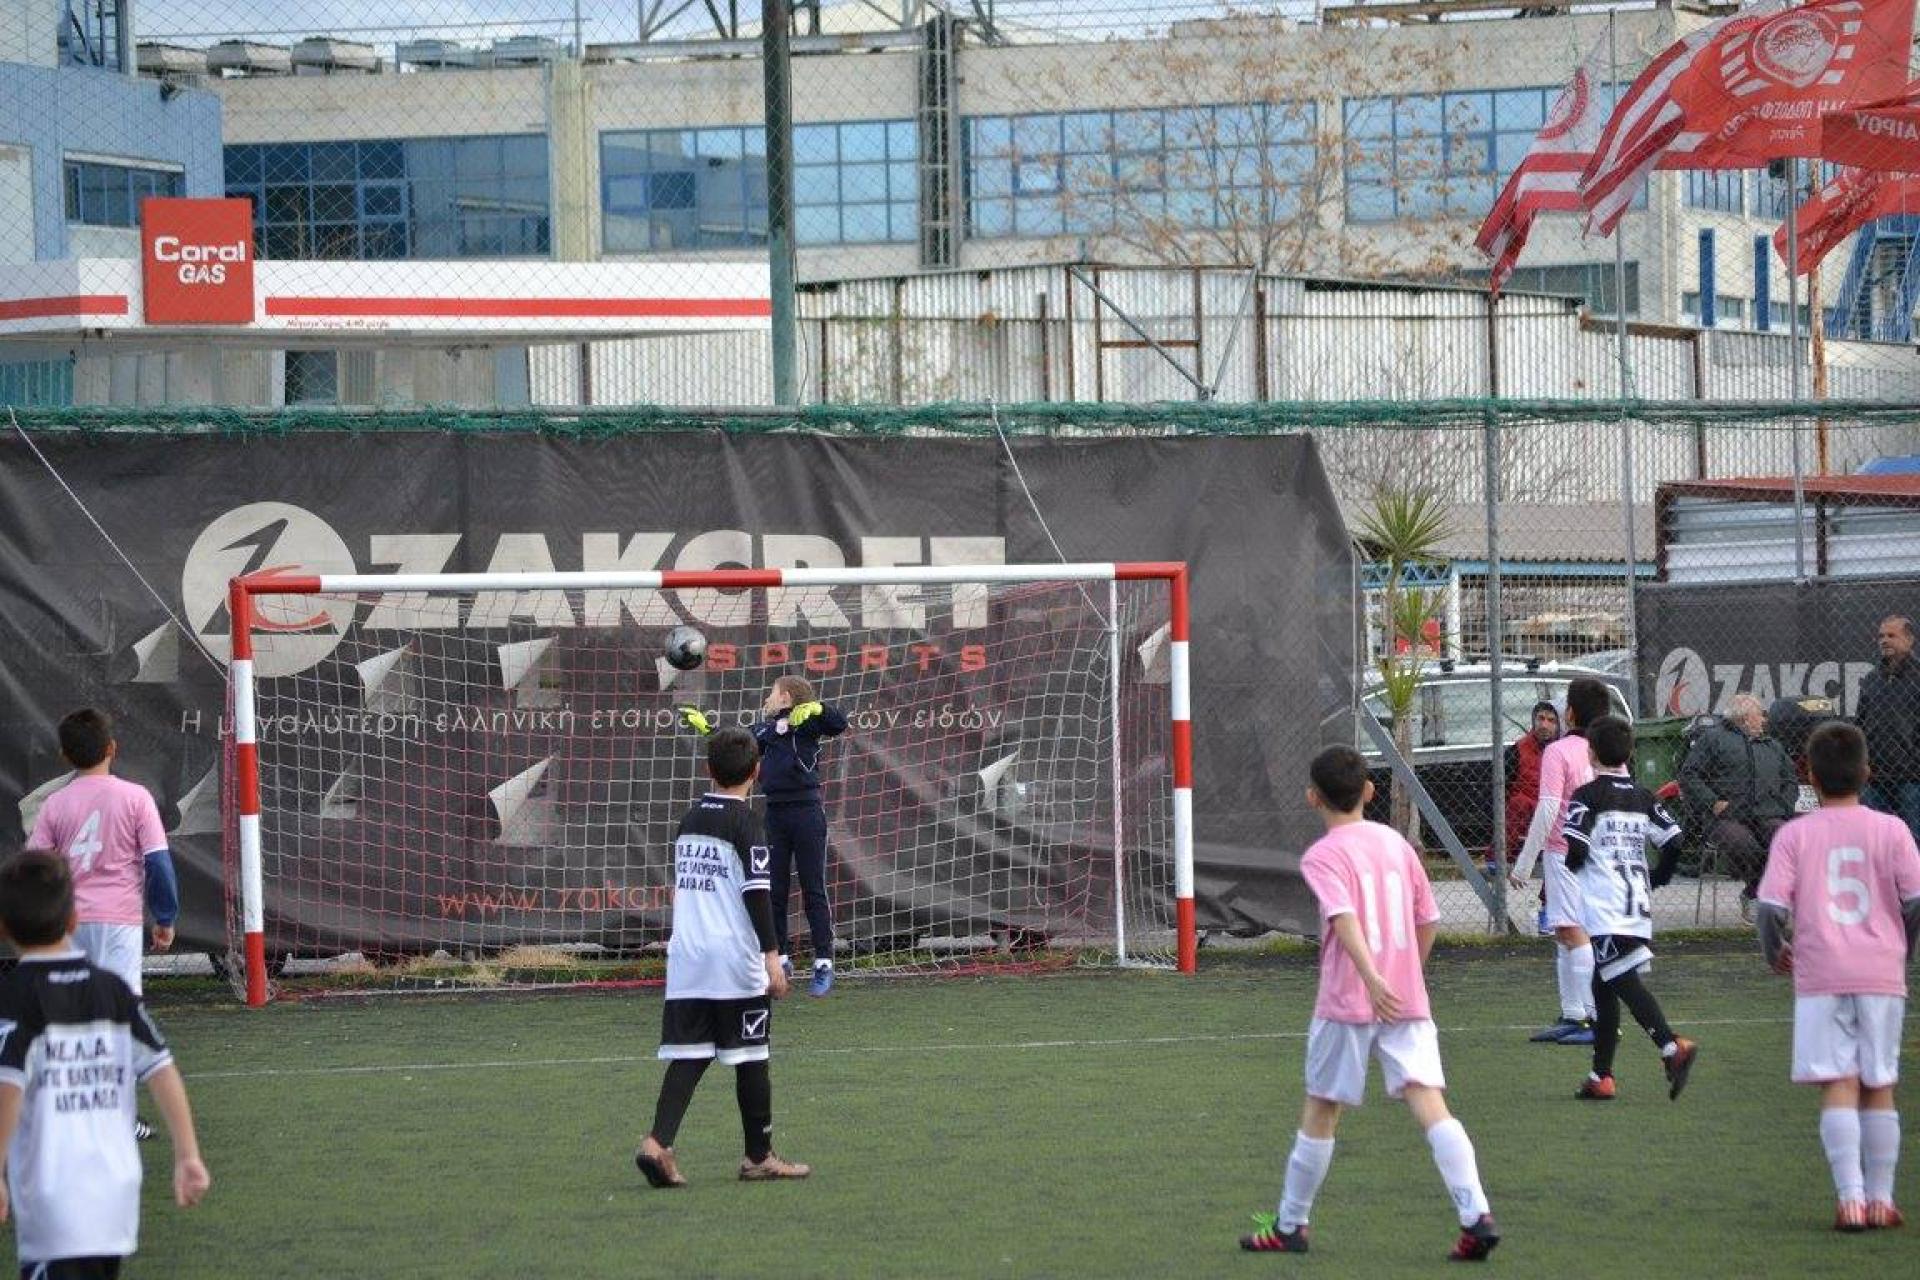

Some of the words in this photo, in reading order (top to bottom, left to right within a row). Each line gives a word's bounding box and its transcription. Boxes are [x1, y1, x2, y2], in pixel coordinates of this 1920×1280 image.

[154, 236, 246, 262] Coral
[179, 263, 226, 285] GAS
[707, 644, 987, 672] SPORTS
[217, 707, 420, 741] μγαλύτερη
[69, 809, 103, 873] 4
[1827, 847, 1871, 925] 5
[1361, 870, 1409, 955] 11
